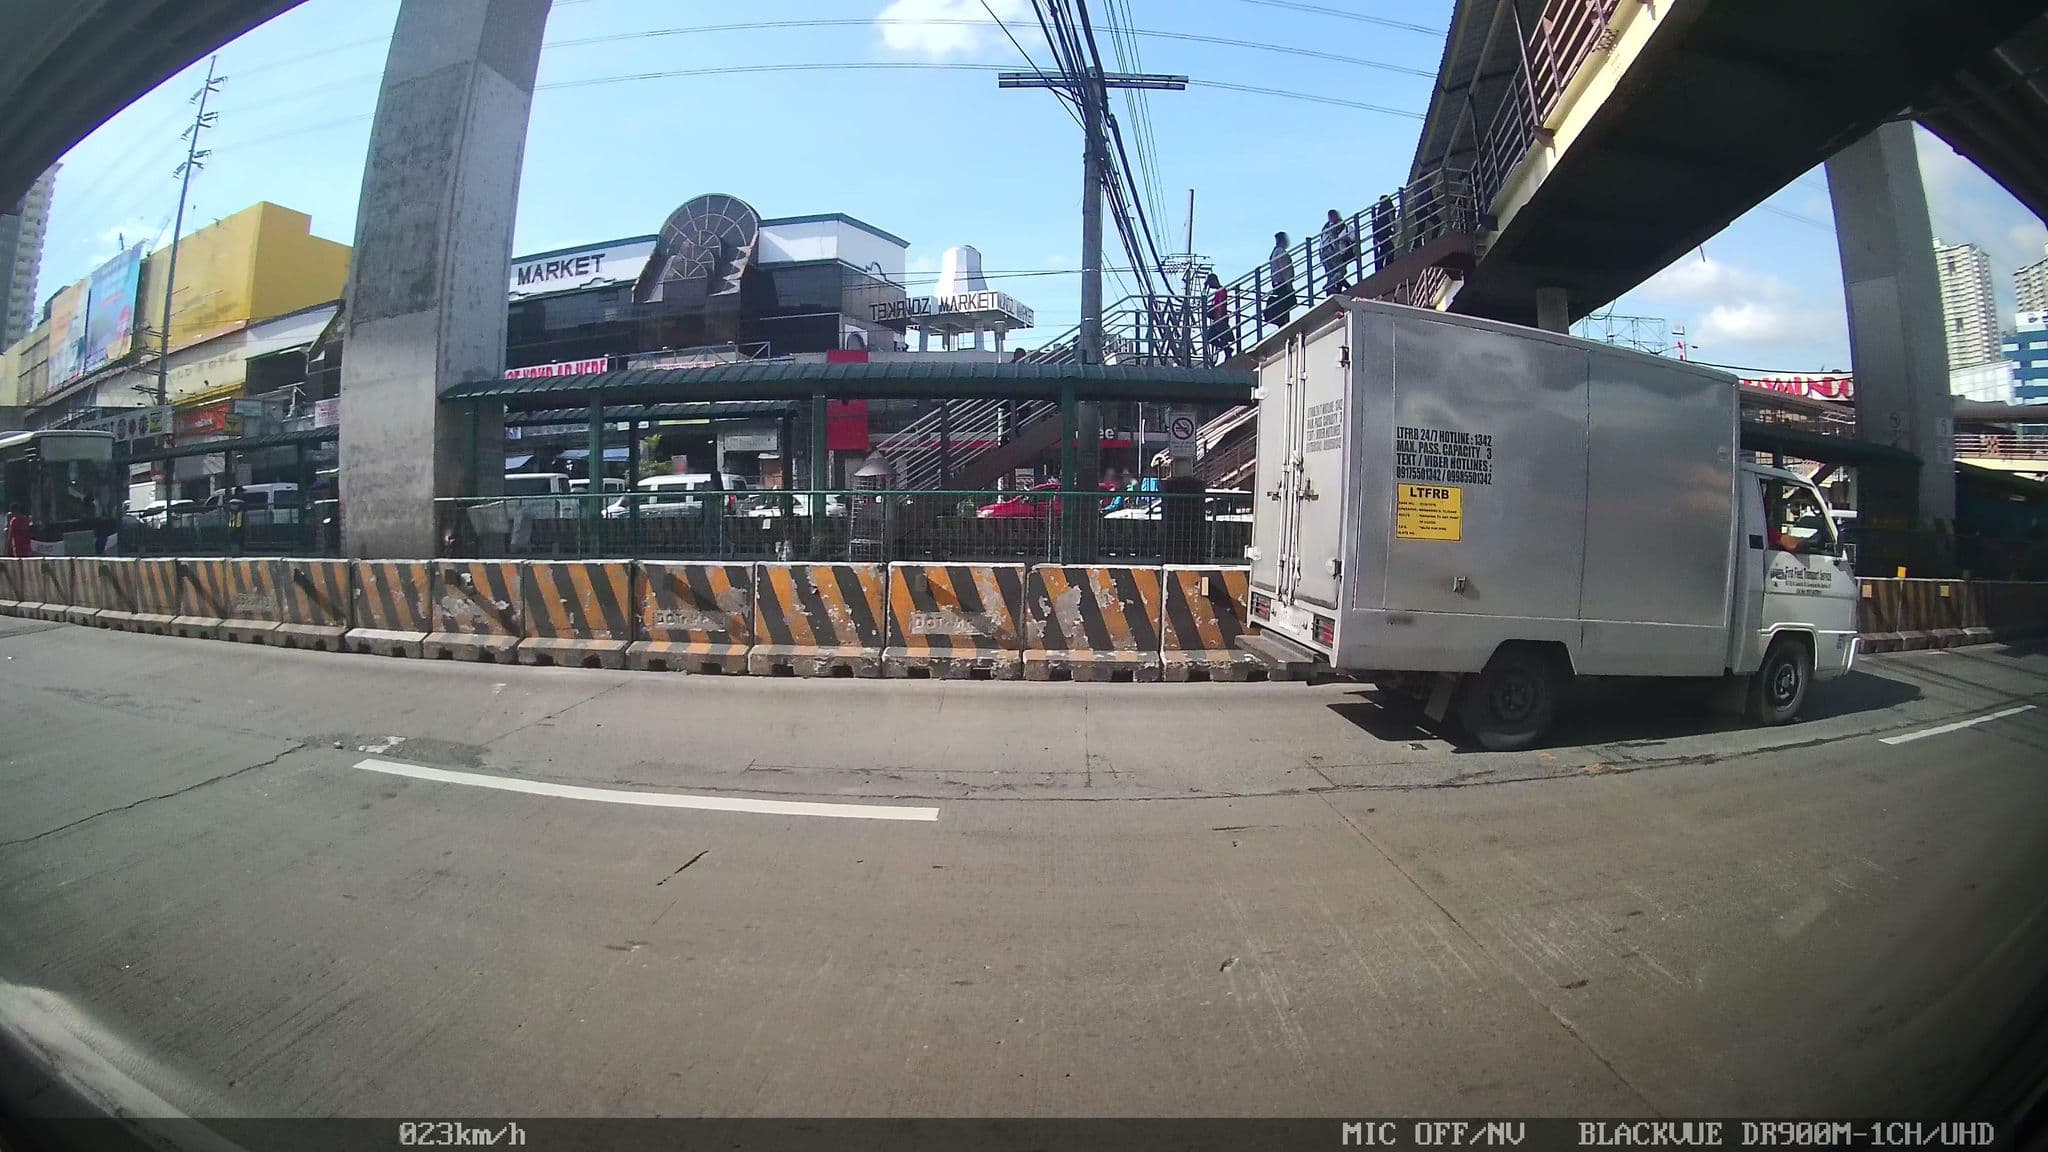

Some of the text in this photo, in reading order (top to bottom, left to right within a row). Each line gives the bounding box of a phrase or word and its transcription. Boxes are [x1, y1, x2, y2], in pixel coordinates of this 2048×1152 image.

[517, 253, 606, 286] MARKET
[939, 291, 997, 313] MARKET
[1397, 426, 1418, 440] LTFRB
[1420, 428, 1438, 442] 24/7
[1440, 430, 1469, 445] HOTLINE
[1475, 433, 1492, 447] 1342
[1397, 440, 1492, 460] MAX. PASS. CAPACITY 3
[1397, 453, 1416, 466] TEXT
[1424, 455, 1448, 469] VIBER
[1450, 457, 1488, 472] HOTLINES
[1410, 486, 1449, 499] LTFRB
